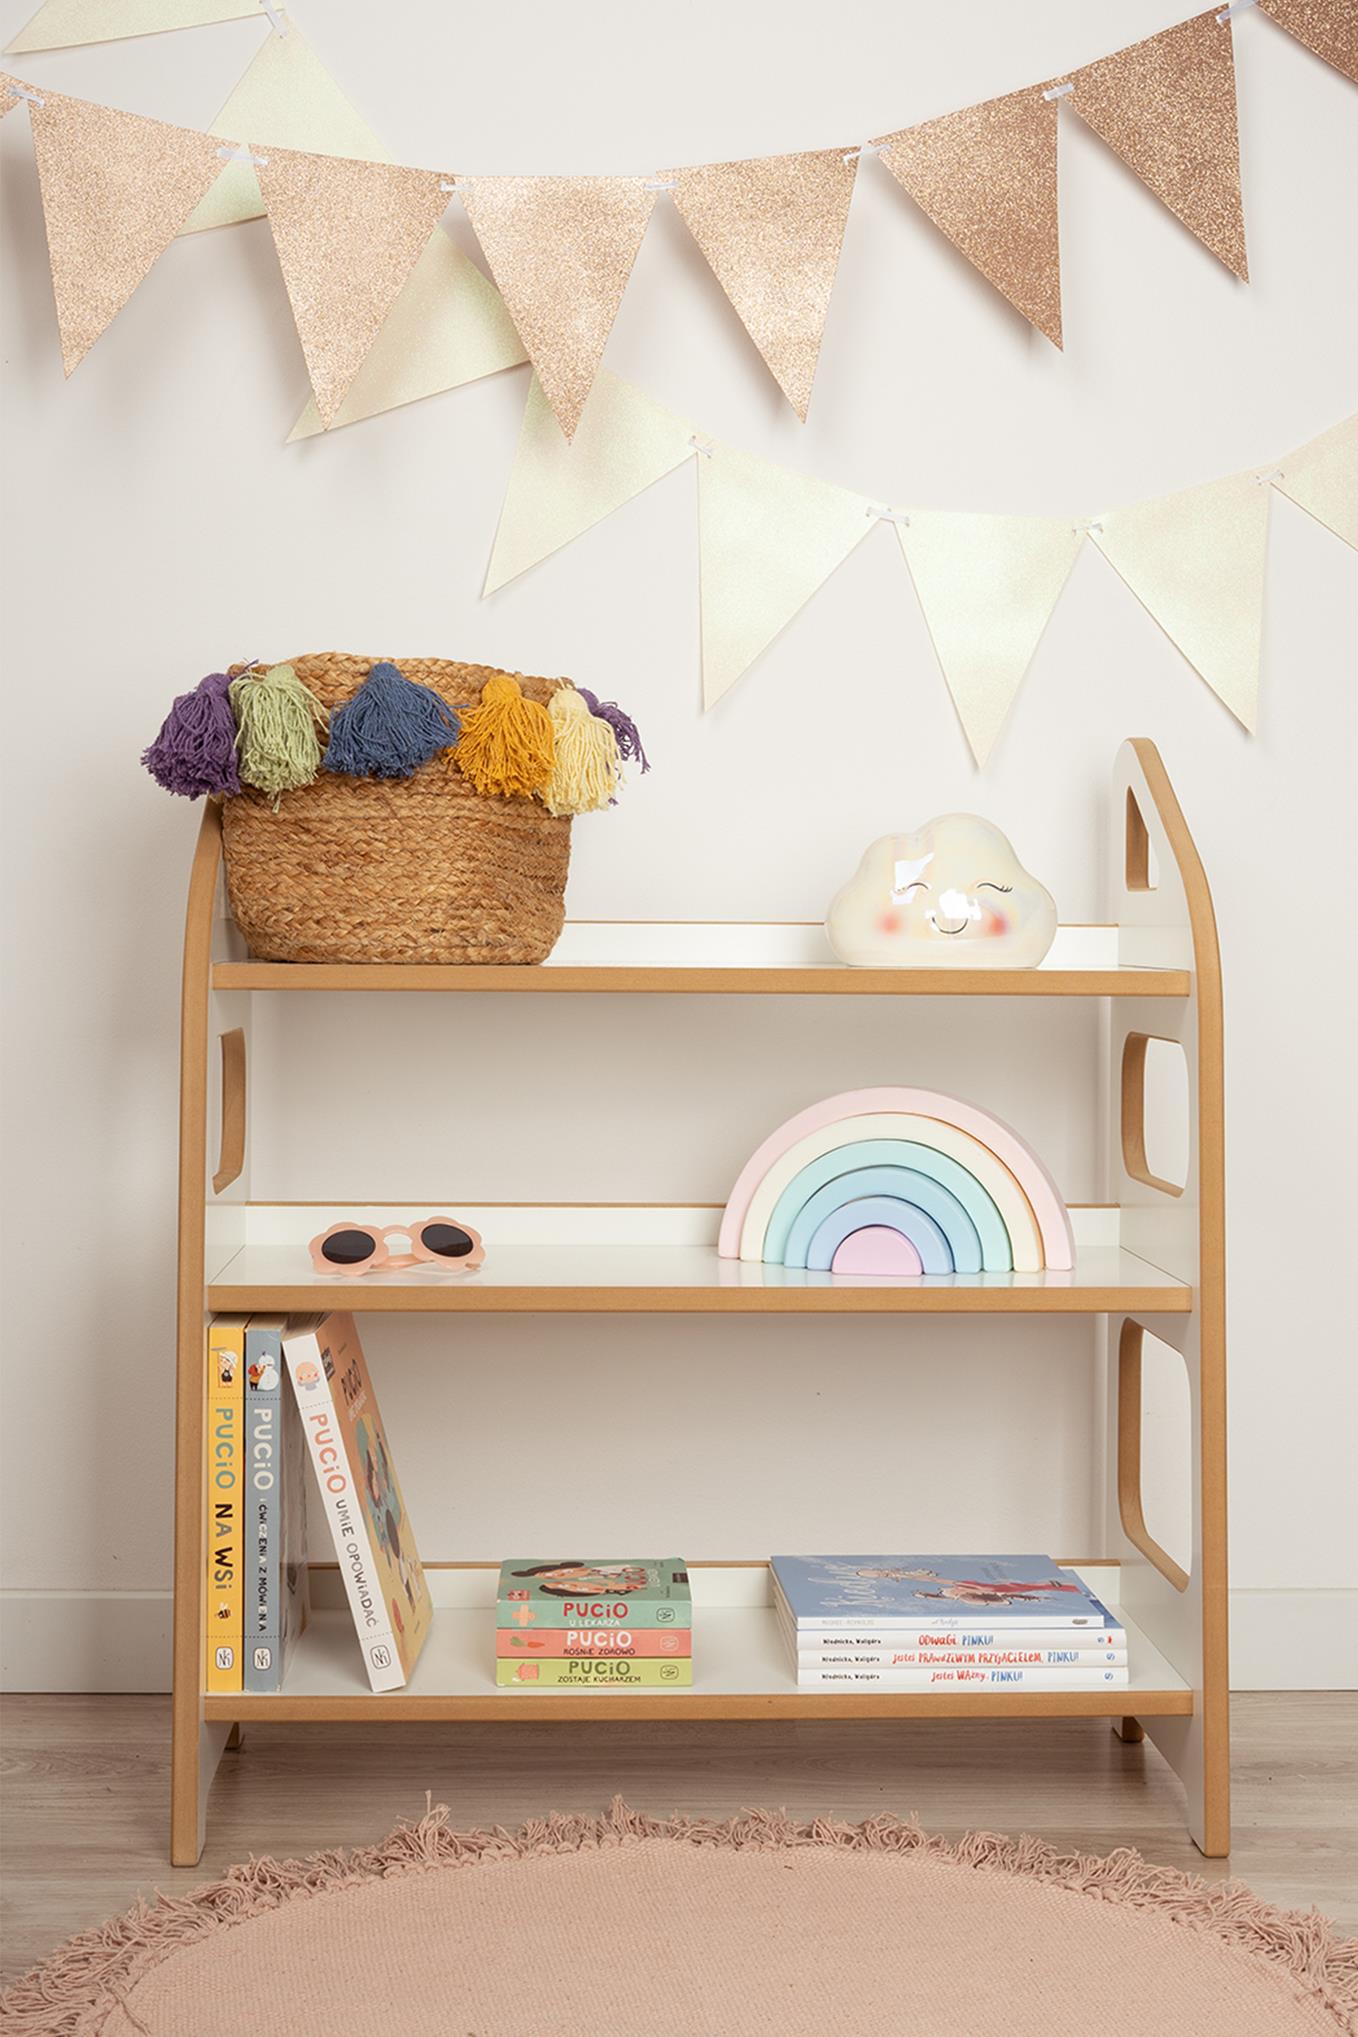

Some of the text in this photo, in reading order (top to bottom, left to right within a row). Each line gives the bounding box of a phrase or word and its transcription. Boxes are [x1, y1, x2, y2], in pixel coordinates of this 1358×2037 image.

[214, 1503, 233, 1538] NA
[335, 1499, 356, 1537] UMiE
[214, 1547, 233, 1590] WSi
[259, 1567, 267, 1575] Z
[345, 1542, 377, 1628] OPOWiADAĆ
[558, 1675, 641, 1683] ZOSTAJE KUCHARZEM
